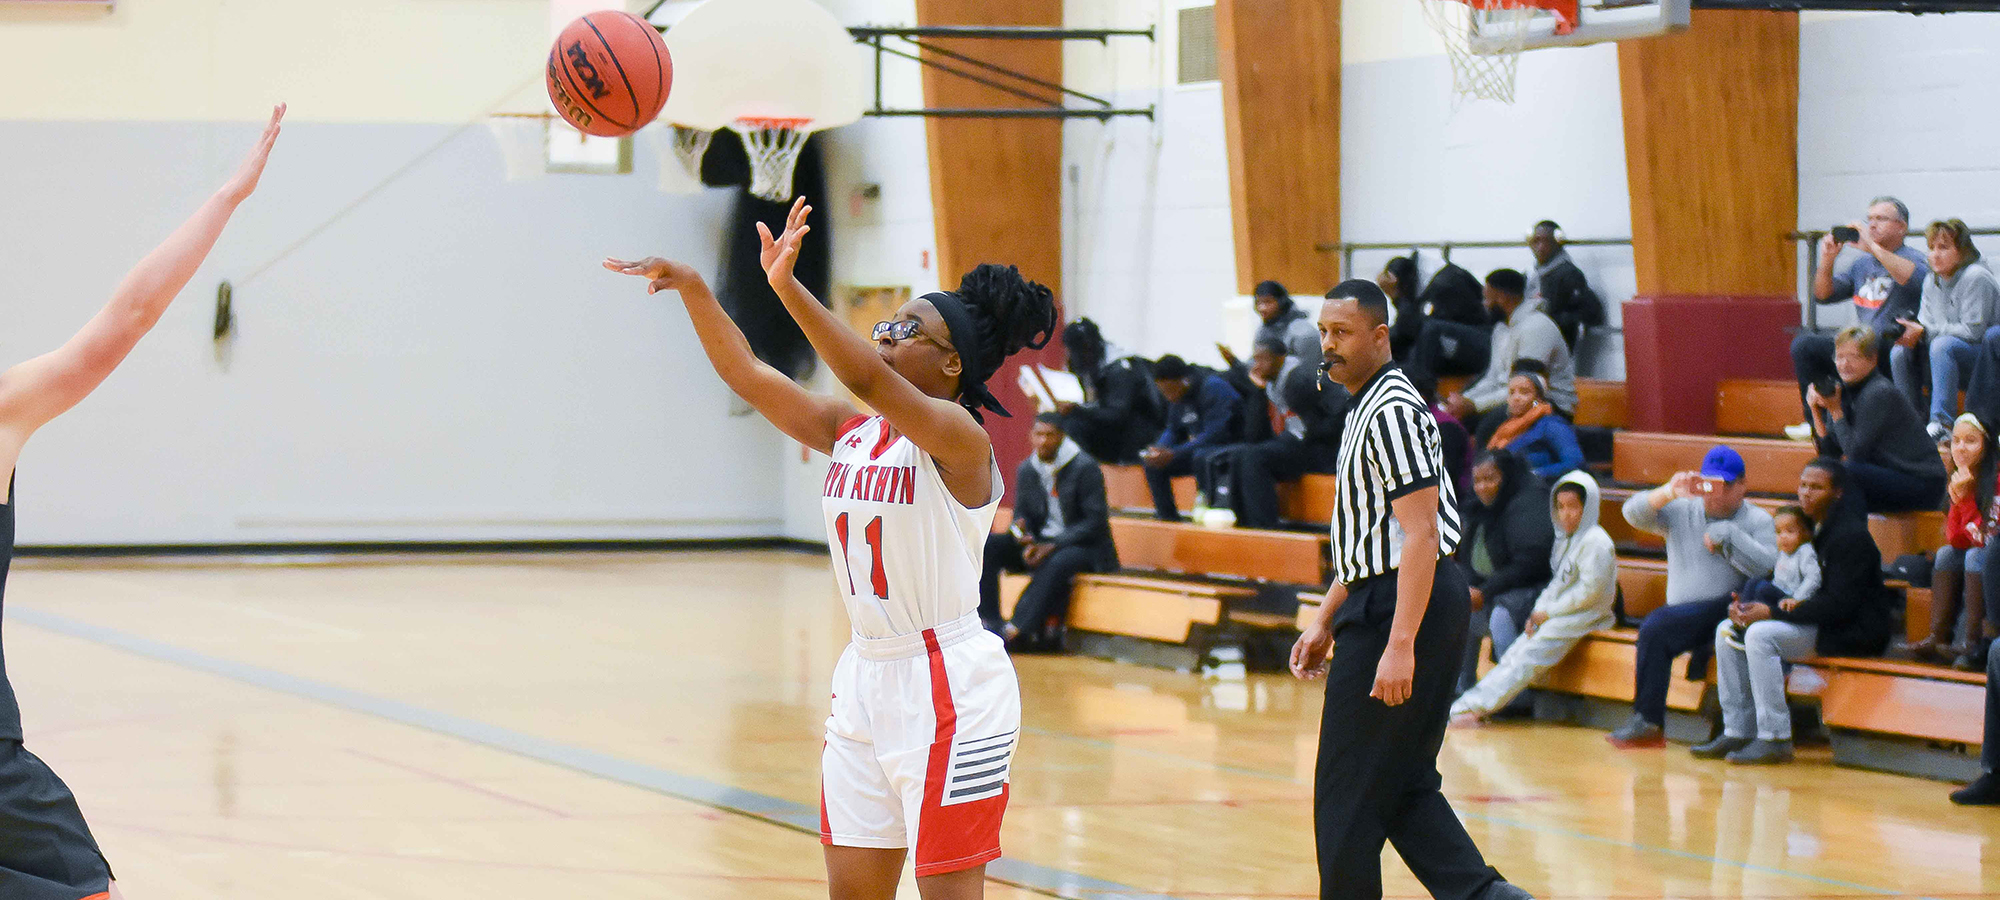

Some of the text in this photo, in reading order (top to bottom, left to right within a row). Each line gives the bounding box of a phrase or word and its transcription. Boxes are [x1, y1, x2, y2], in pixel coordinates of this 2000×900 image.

[567, 40, 611, 99] NCAA
[850, 465, 917, 505] ATHYN
[835, 512, 890, 600] 11
